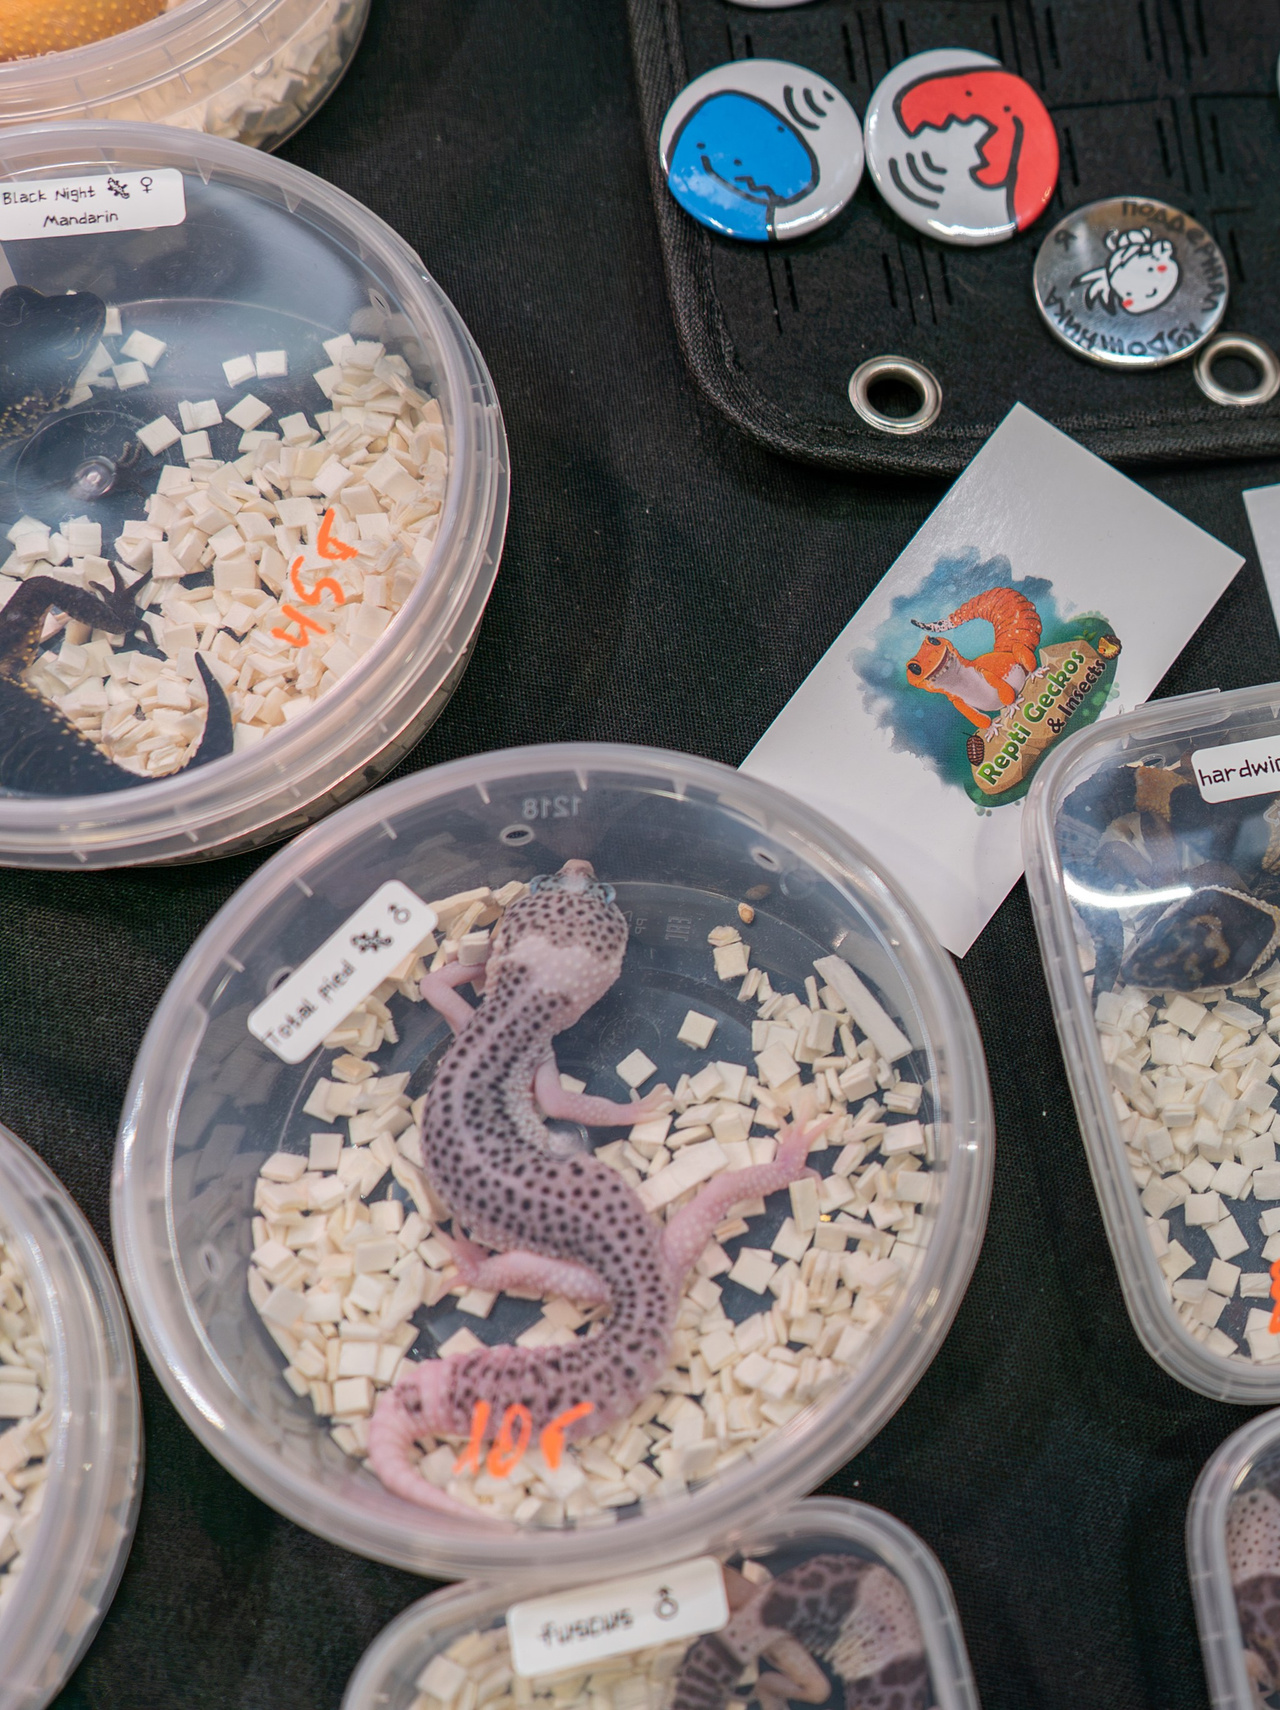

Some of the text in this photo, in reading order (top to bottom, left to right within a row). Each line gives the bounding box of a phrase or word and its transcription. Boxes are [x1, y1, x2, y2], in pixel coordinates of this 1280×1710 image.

[2, 185, 96, 205] Black Night
[43, 210, 119, 228] Mandarin
[977, 650, 1085, 786] Repti Geckos
[1047, 659, 1106, 734] & Insects
[262, 998, 319, 1047] Total
[539, 1607, 634, 1647] fuscus
